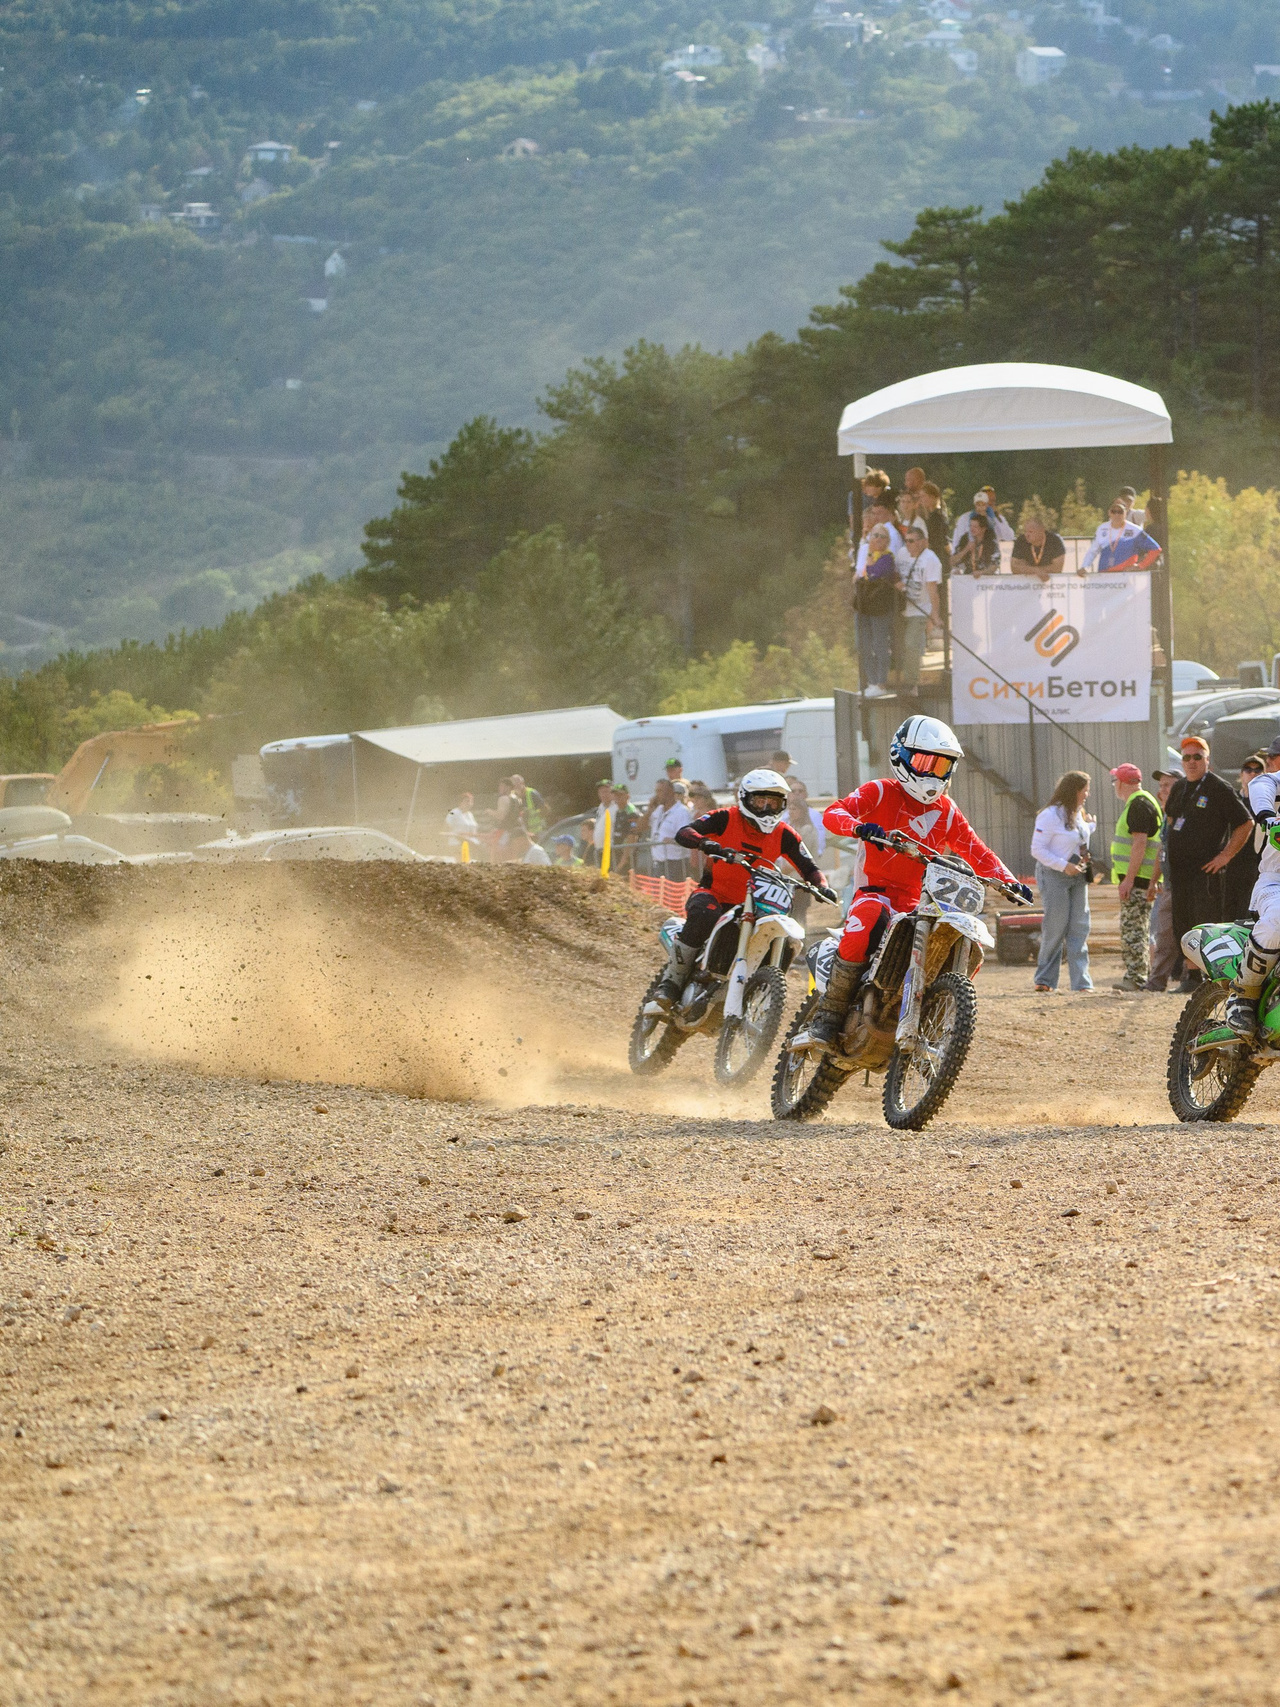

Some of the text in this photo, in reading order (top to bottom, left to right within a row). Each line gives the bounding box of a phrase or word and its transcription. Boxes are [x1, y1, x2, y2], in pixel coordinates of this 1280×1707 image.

[968, 676, 1137, 700] СитиБетон
[753, 880, 792, 909] 700
[931, 877, 982, 913] 26
